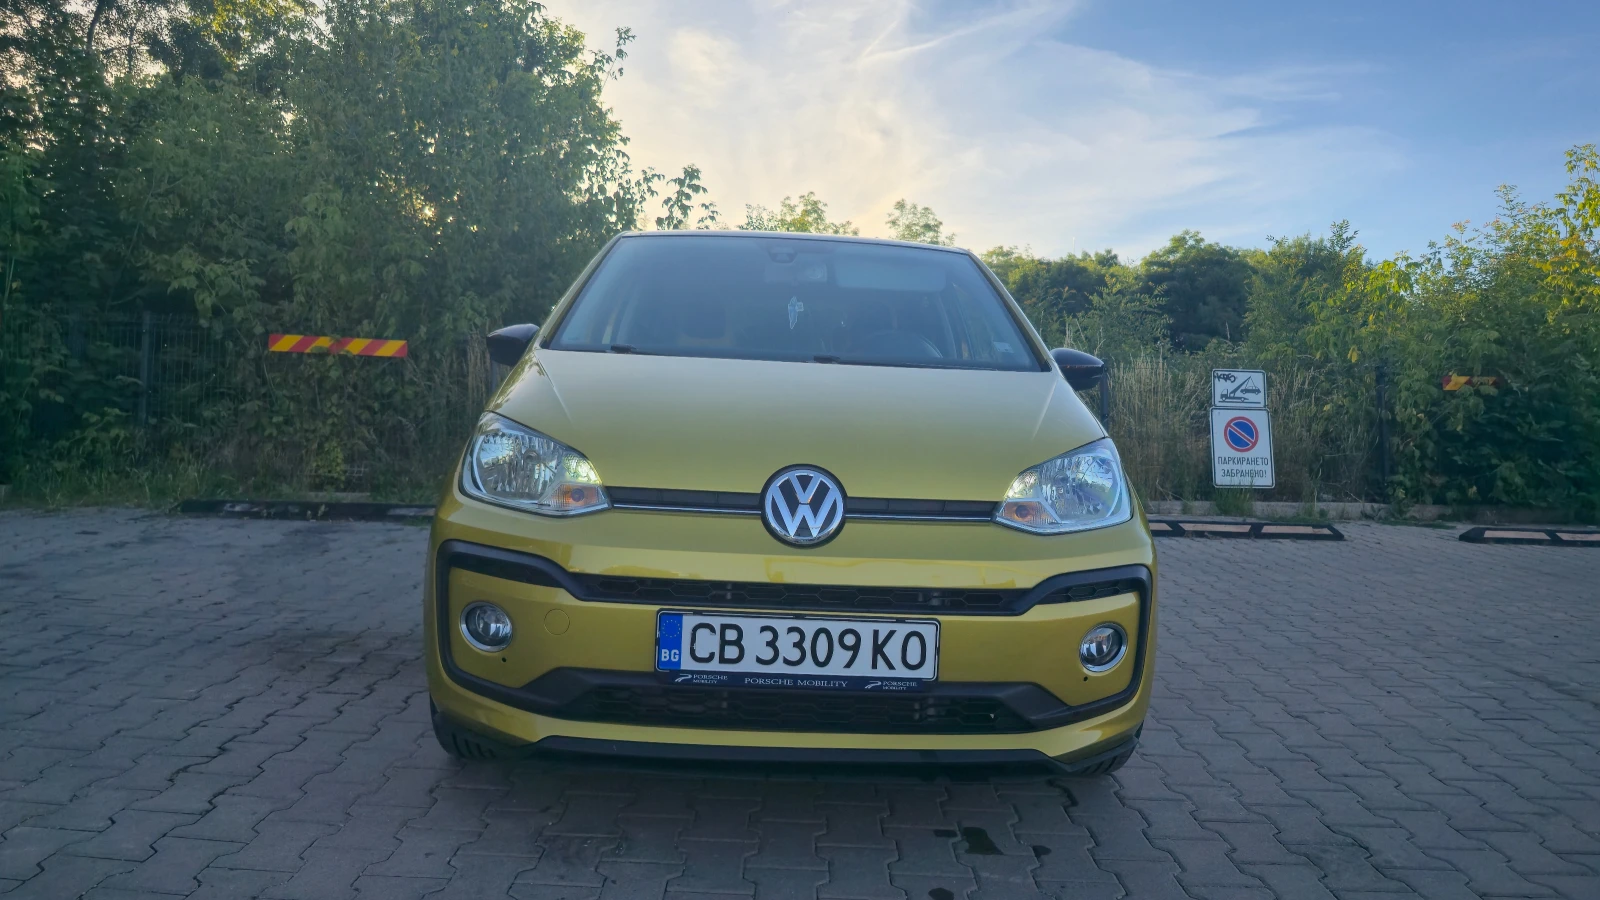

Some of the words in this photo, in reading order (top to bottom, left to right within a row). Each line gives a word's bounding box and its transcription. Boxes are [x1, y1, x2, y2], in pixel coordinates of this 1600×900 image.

[1217, 456, 1269, 466] ПАРКИРАНЕТО
[1221, 468, 1267, 478] ЗАБРАНЕНО!
[689, 622, 745, 665] CB
[755, 624, 862, 669] 3309
[871, 629, 927, 671] KO
[661, 649, 680, 662] BG
[744, 677, 794, 686] PORSCHE
[797, 679, 849, 688] MOBILITY
